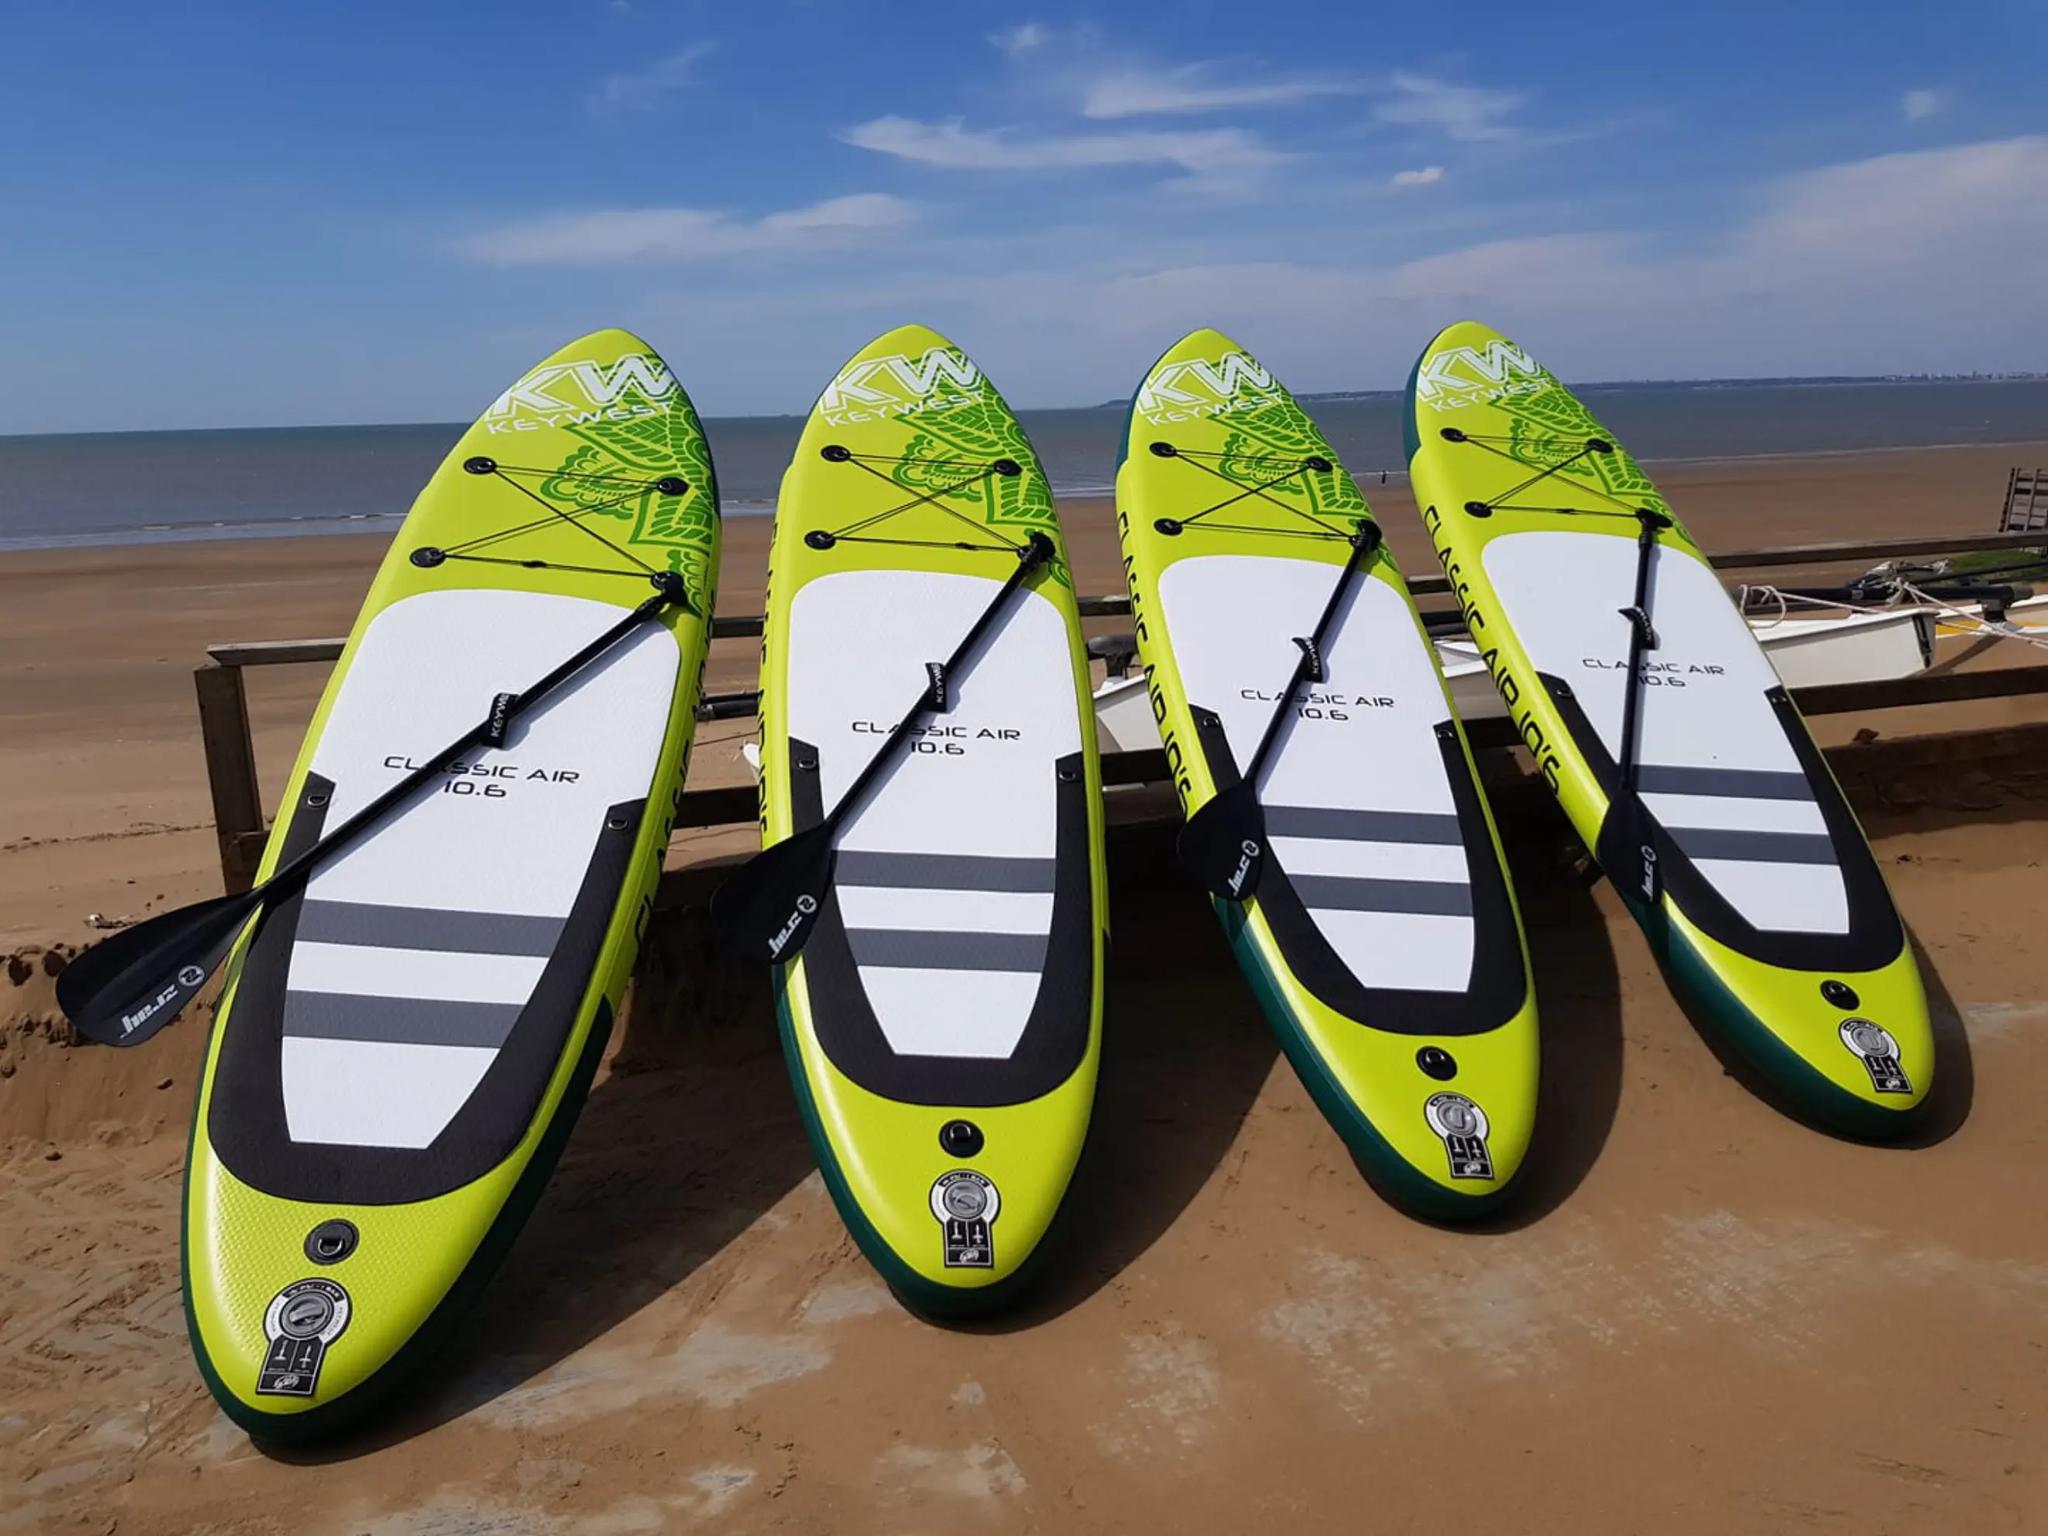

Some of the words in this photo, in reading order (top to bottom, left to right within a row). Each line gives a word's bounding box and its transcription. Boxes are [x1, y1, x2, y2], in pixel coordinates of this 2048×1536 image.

[1416, 339, 1543, 402] KW
[484, 353, 679, 421] KW
[818, 347, 983, 415] KW
[1135, 352, 1278, 415] KW
[1582, 658, 1681, 673] CLASIC
[1688, 664, 1725, 675] AIR
[1638, 675, 1686, 687] 10.6
[1355, 696, 1395, 708] AIR
[1298, 707, 1349, 721] 10.6
[976, 728, 1021, 740] AIR
[911, 741, 965, 756] 10.6
[384, 756, 519, 779] CLSSIC
[526, 769, 580, 784] AIR
[444, 781, 507, 798] 10.6
